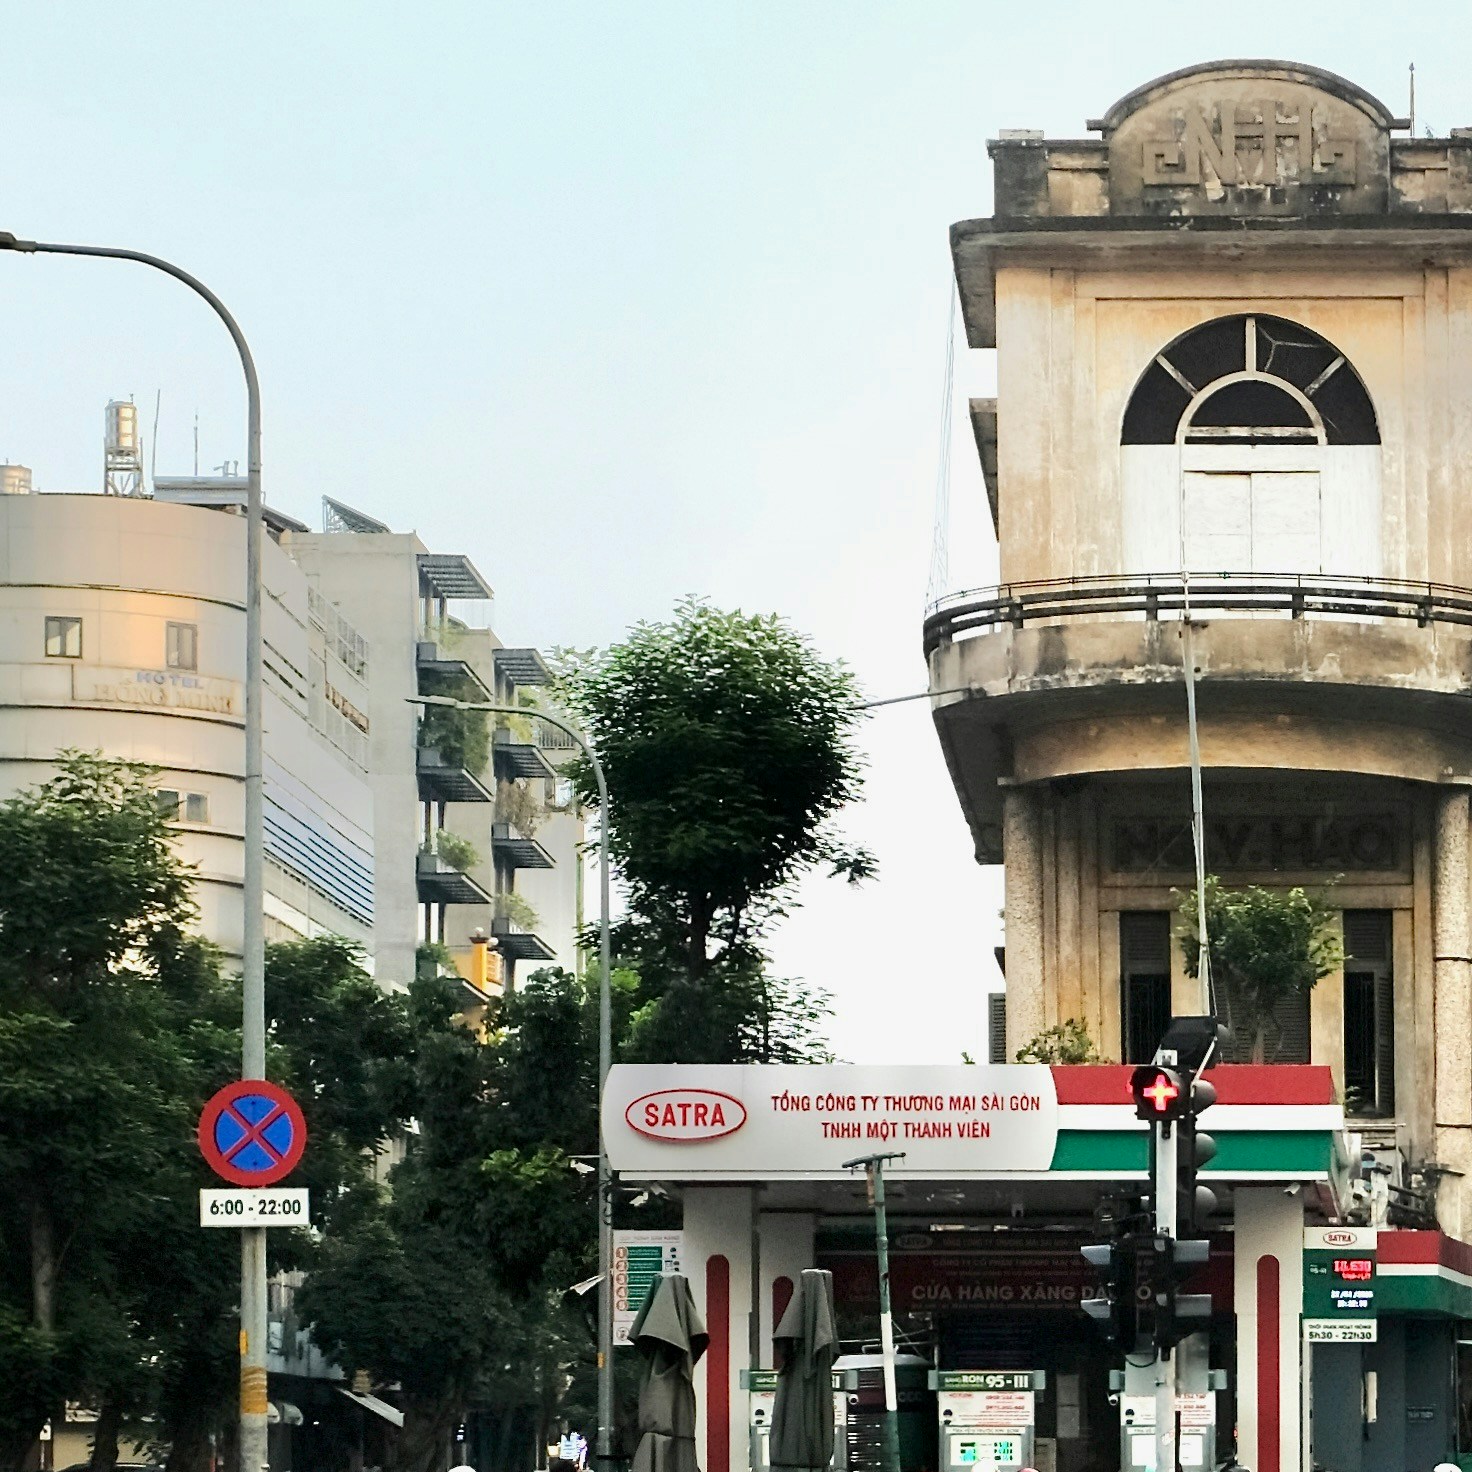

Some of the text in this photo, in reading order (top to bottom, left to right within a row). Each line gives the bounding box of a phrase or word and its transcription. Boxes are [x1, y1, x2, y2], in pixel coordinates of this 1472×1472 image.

[137, 671, 204, 689] HOTEL
[771, 1090, 1040, 1114] TỔNG CÔNG TY THƯƠNG MẠI SÀI GÒN
[644, 1103, 725, 1126] SATRA
[821, 1117, 990, 1142] TNHH MỘT THÀNH VIÊN
[210, 1199, 243, 1215] 6:00
[258, 1199, 301, 1215] 22:00
[911, 1279, 949, 1300] CỬA
[958, 1279, 1014, 1300] HÀNG
[1020, 1281, 1075, 1300] XĂNG
[962, 1375, 984, 1383] RON
